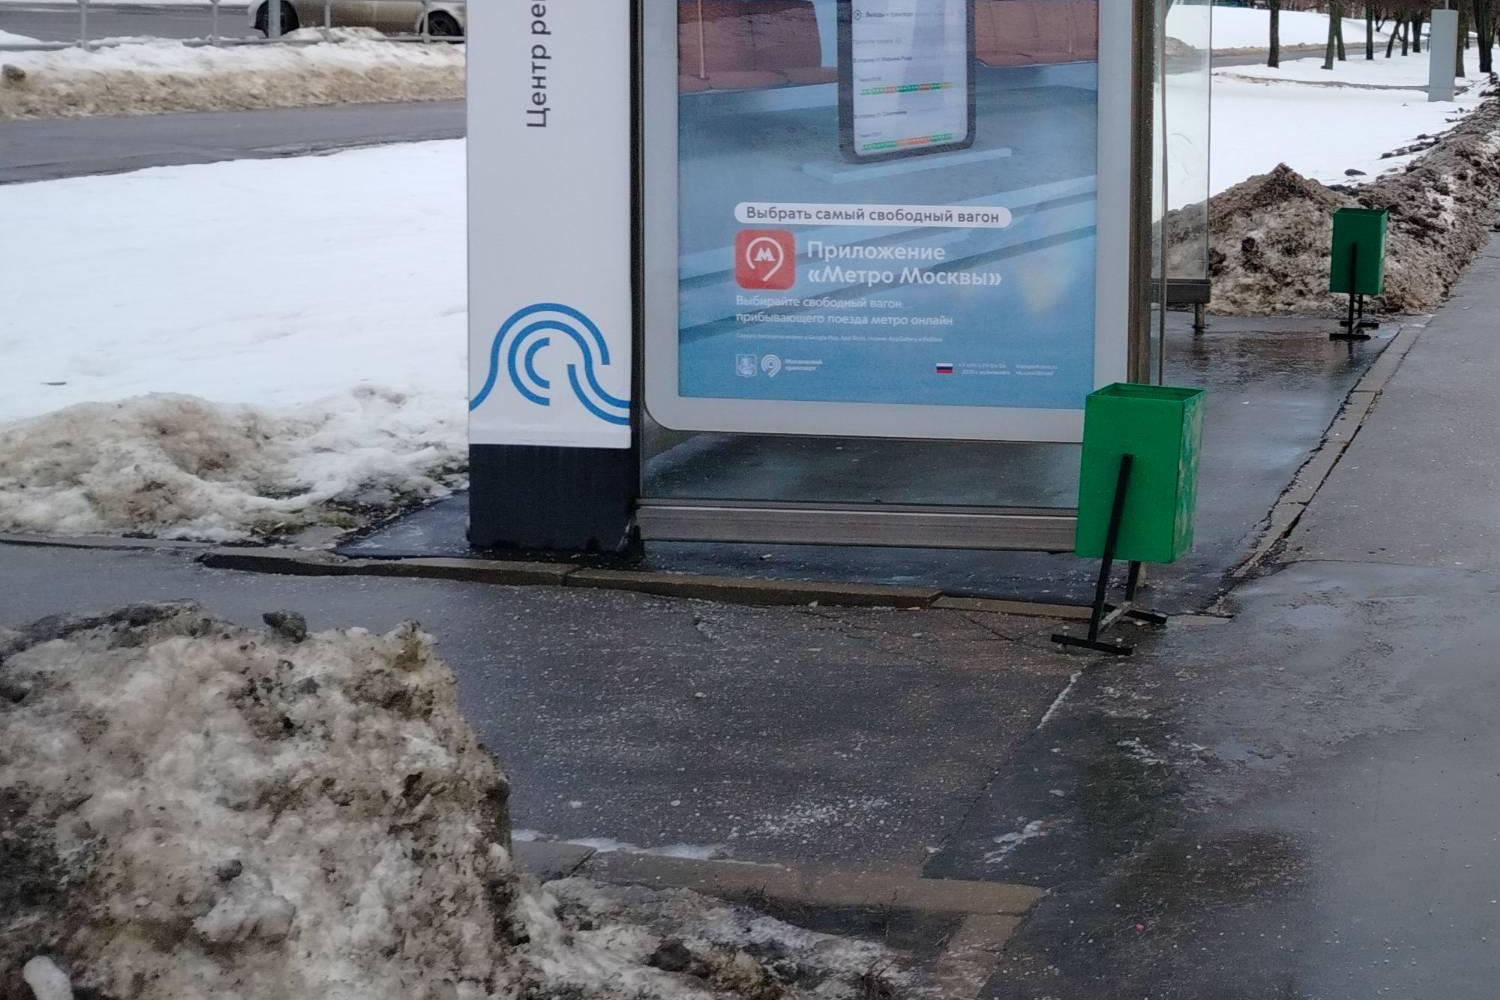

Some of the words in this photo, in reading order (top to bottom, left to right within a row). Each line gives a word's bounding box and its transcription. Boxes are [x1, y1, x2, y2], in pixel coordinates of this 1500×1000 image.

[526, 44, 552, 128] Центр
[746, 206, 812, 221] Выбрать
[815, 208, 865, 221] самый
[868, 208, 954, 223] свободный
[957, 212, 1000, 223] вагон
[807, 240, 946, 262] Приложение
[807, 265, 894, 287] «Метро
[899, 267, 1003, 286] Москвы»
[735, 294, 801, 307] Выбирайте
[802, 296, 867, 309] свободный
[869, 299, 902, 309] вагон
[735, 311, 825, 324] прибывающего
[827, 315, 868, 326] поезда
[870, 316, 908, 327] метро
[909, 314, 953, 326] онлайн
